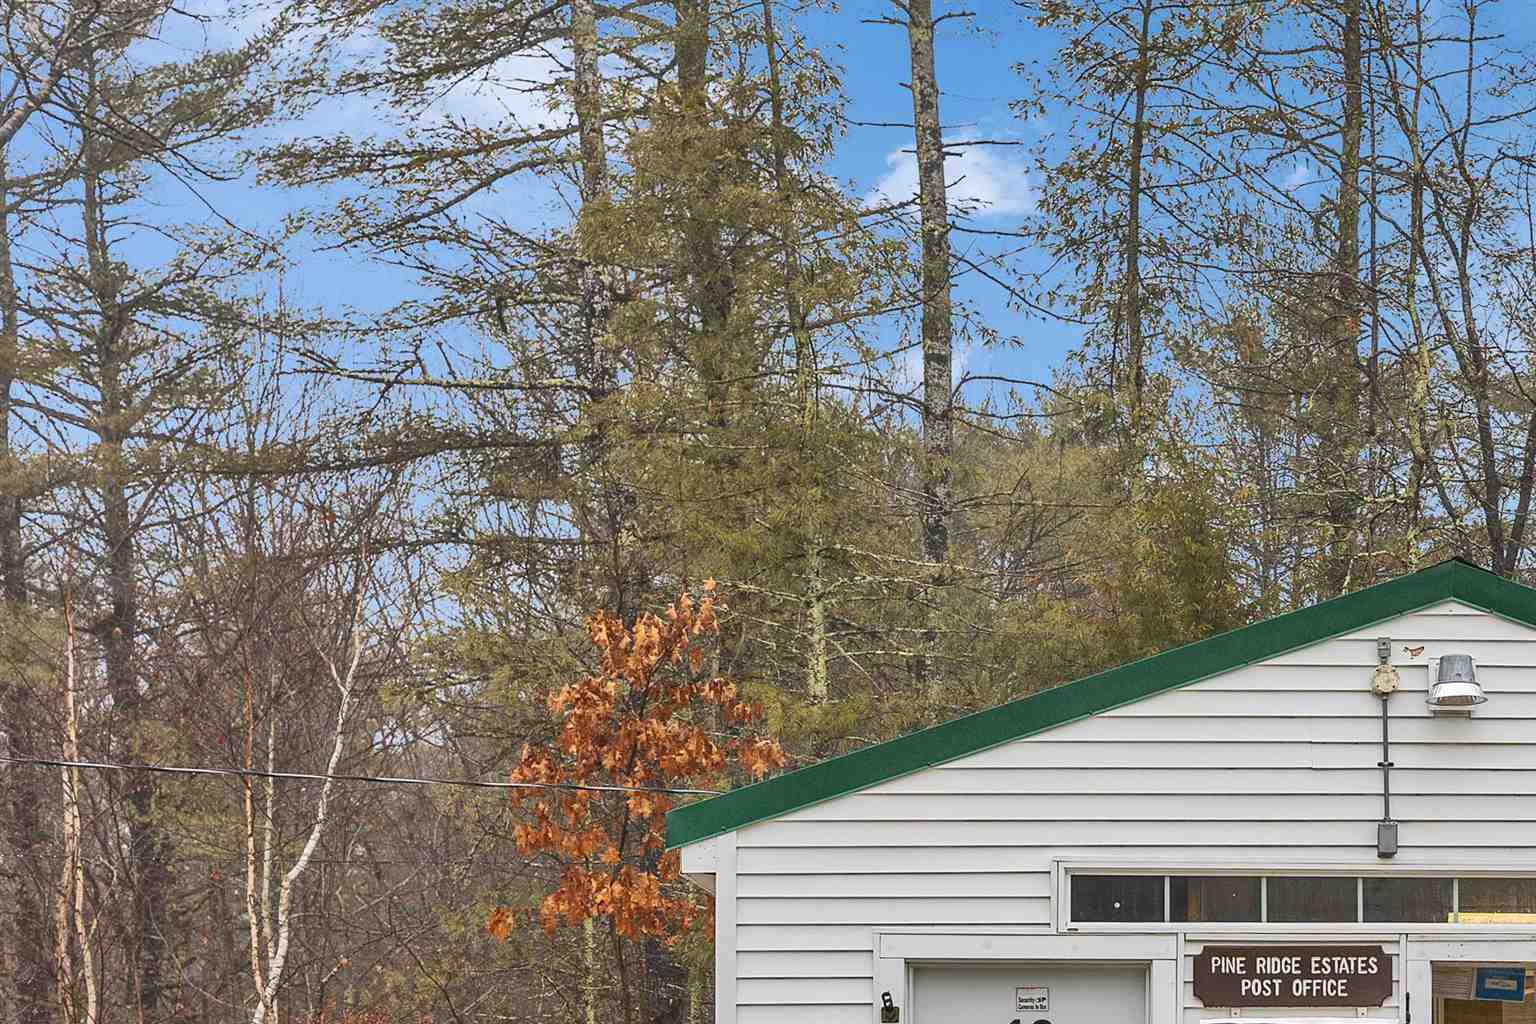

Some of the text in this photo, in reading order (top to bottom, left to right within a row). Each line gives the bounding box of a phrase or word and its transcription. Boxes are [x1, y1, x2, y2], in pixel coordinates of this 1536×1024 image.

[1211, 956, 1379, 975] PINE RIDGE ESTATES
[1241, 979, 1348, 997] POST OFFICE
